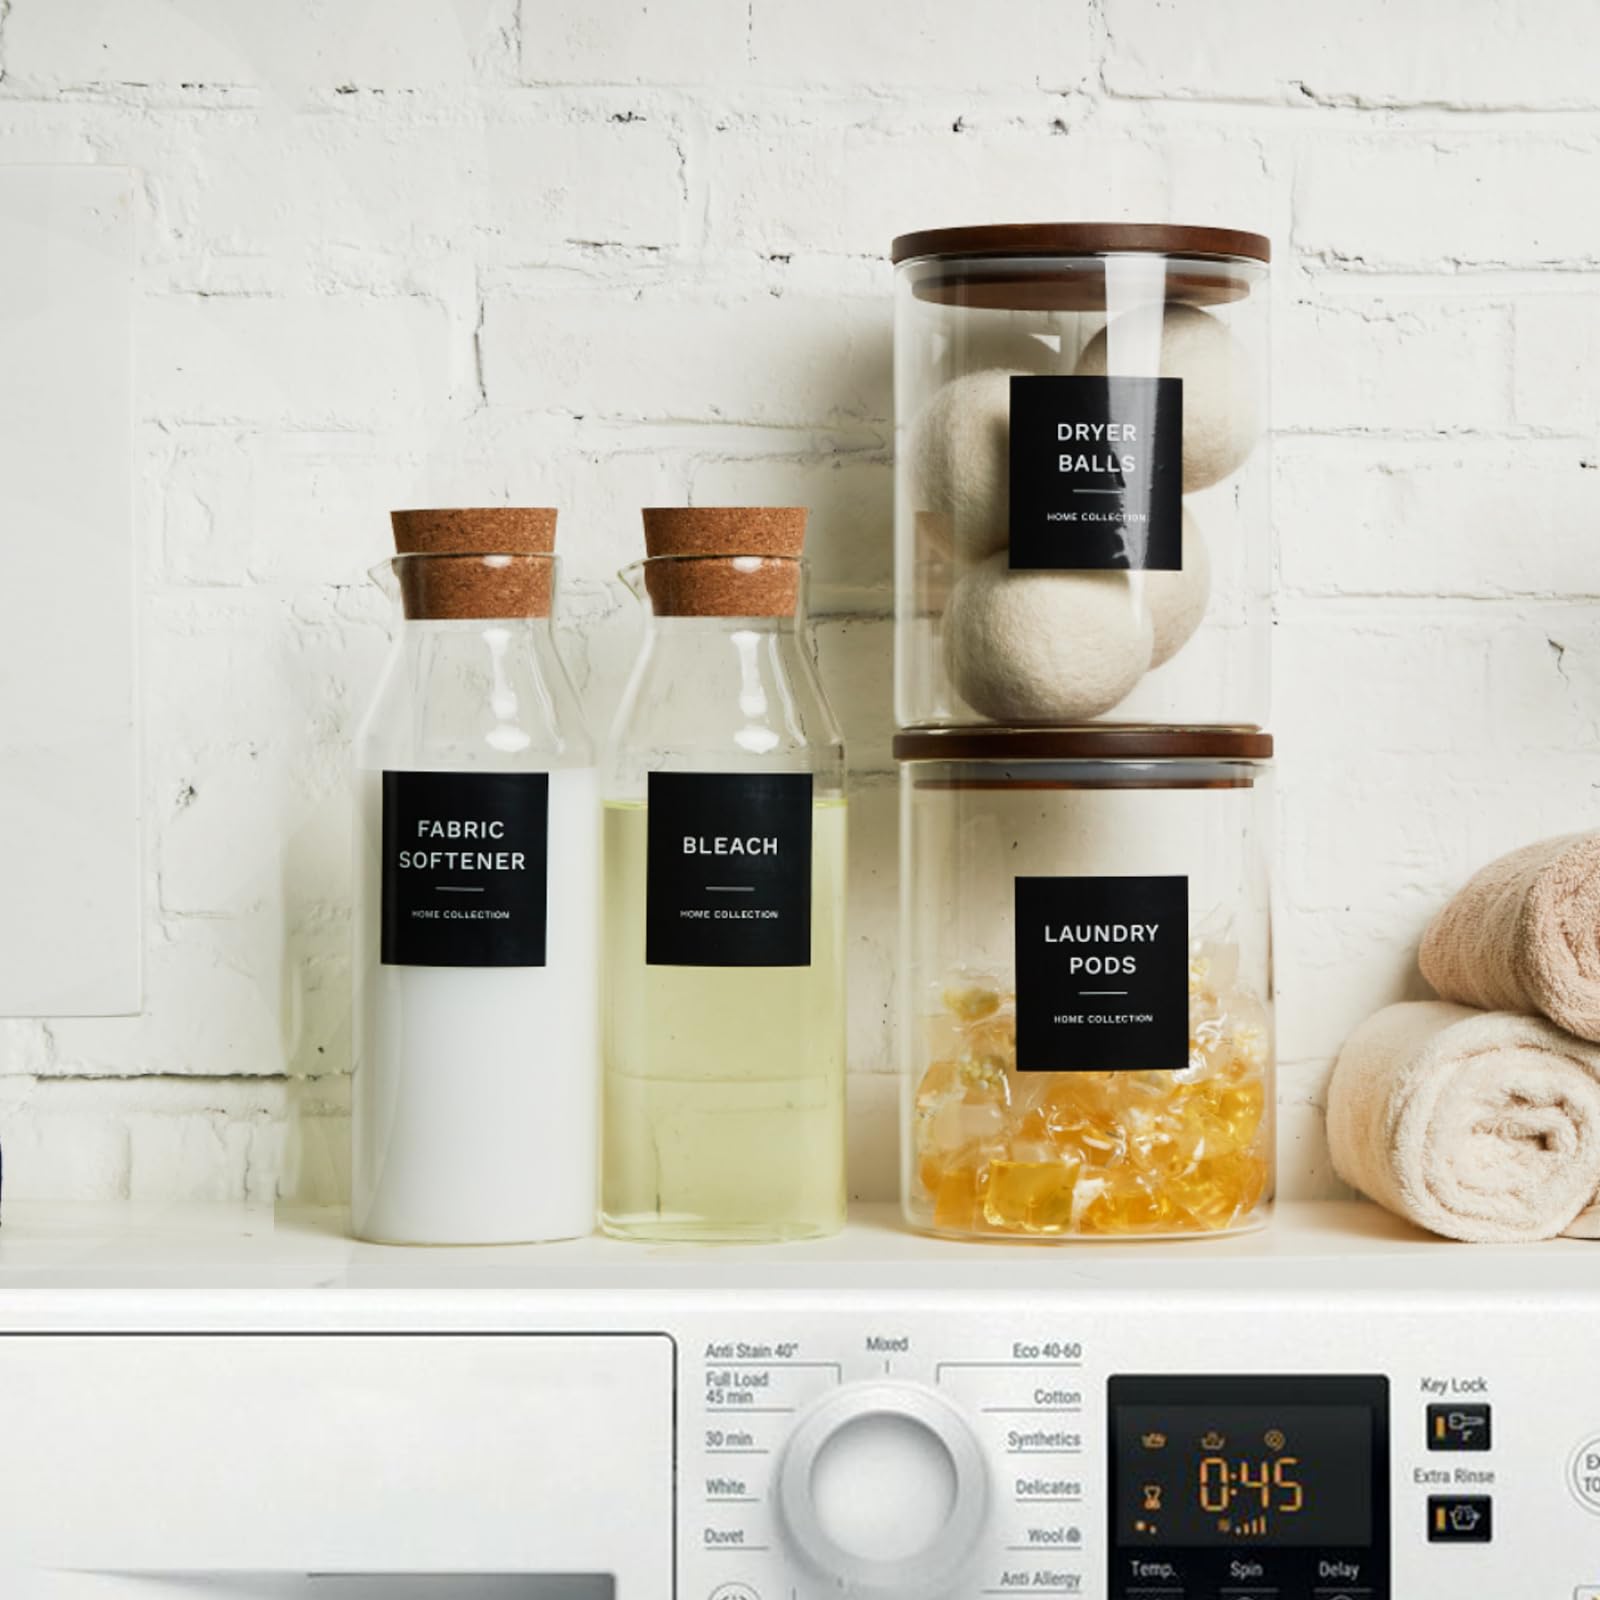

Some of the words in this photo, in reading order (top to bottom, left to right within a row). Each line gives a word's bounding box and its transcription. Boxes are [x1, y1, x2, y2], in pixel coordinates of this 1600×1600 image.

[1057, 423, 1137, 442] DRYER
[1058, 454, 1136, 473] BALLS
[1047, 512, 1078, 522] HOME
[1081, 512, 1147, 522] COLLECTION
[417, 820, 505, 839] FABRIC
[682, 836, 778, 856] BLEACH
[399, 851, 526, 870] SOFTENER
[411, 910, 440, 919] HOME
[443, 910, 510, 920] COLLECTION
[680, 910, 710, 919] HOME
[714, 910, 779, 919] COLLECTION
[1045, 924, 1159, 943] LAUNDRY
[1070, 956, 1137, 975] PODS
[1053, 1014, 1084, 1024] HOME
[1087, 1014, 1153, 1024] COLLECTION
[705, 1343, 734, 1359] Anti
[736, 1343, 772, 1359] Stain
[866, 1336, 909, 1353] Mixed
[1012, 1342, 1041, 1359] Eco
[1042, 1342, 1082, 1359] 40-60
[705, 1371, 731, 1388] Full
[733, 1371, 769, 1388] Load
[1420, 1377, 1447, 1396] Key
[1451, 1376, 1488, 1393] Lock
[706, 1389, 725, 1404] 45
[727, 1390, 754, 1404] min
[1033, 1388, 1082, 1405] Cotton
[705, 1430, 724, 1446] 30
[725, 1431, 753, 1446] min
[1007, 1430, 1082, 1450] Synthetics
[1413, 1467, 1449, 1484] Extra
[1451, 1467, 1495, 1484] Rinse
[705, 1478, 746, 1495] White
[1015, 1478, 1082, 1495] Delicates
[1200, 1457, 1303, 1512] 0:45
[704, 1527, 744, 1544] Duvet
[1027, 1527, 1064, 1544] Wool
[1131, 1560, 1177, 1580] Temp.
[1229, 1560, 1264, 1581] Spin
[1318, 1560, 1361, 1582] Delay
[1000, 1571, 1030, 1587] Anti
[1032, 1571, 1082, 1591] Allergy
